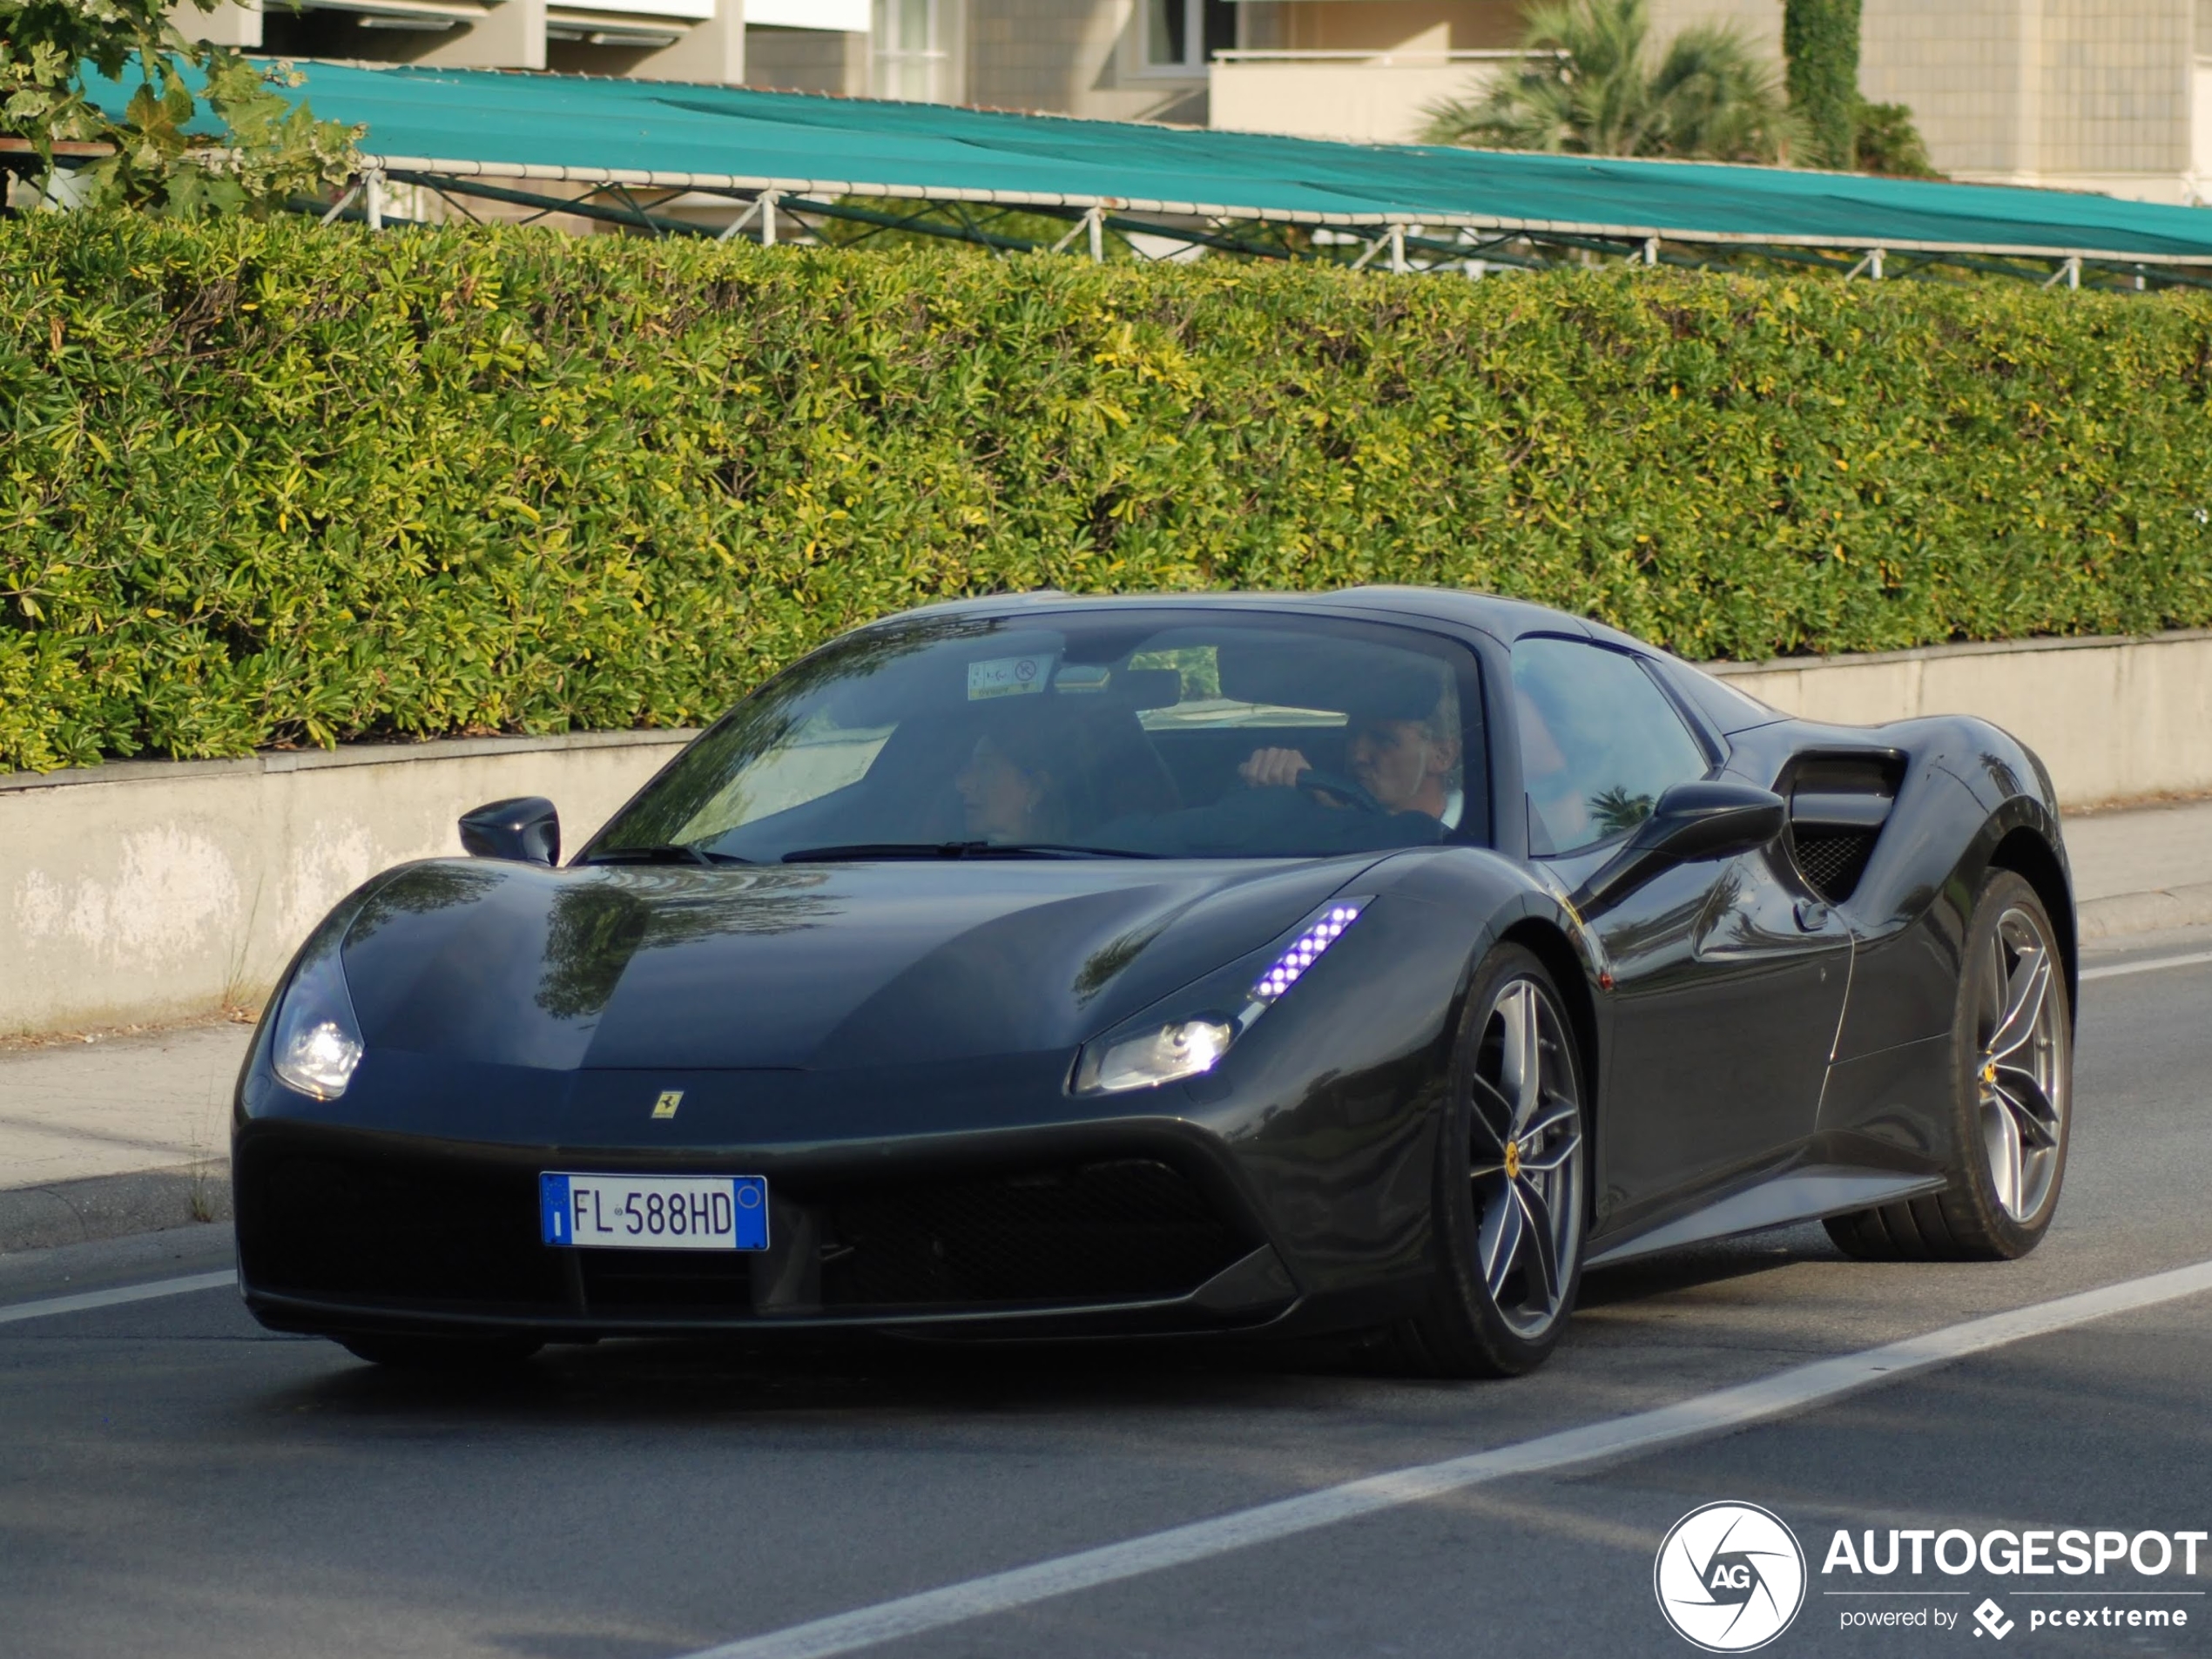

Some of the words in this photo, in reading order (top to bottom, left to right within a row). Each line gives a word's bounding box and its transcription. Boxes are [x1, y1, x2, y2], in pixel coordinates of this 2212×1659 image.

[554, 1211, 561, 1237] I
[573, 1189, 613, 1232] FL
[625, 1192, 732, 1235] 588HD
